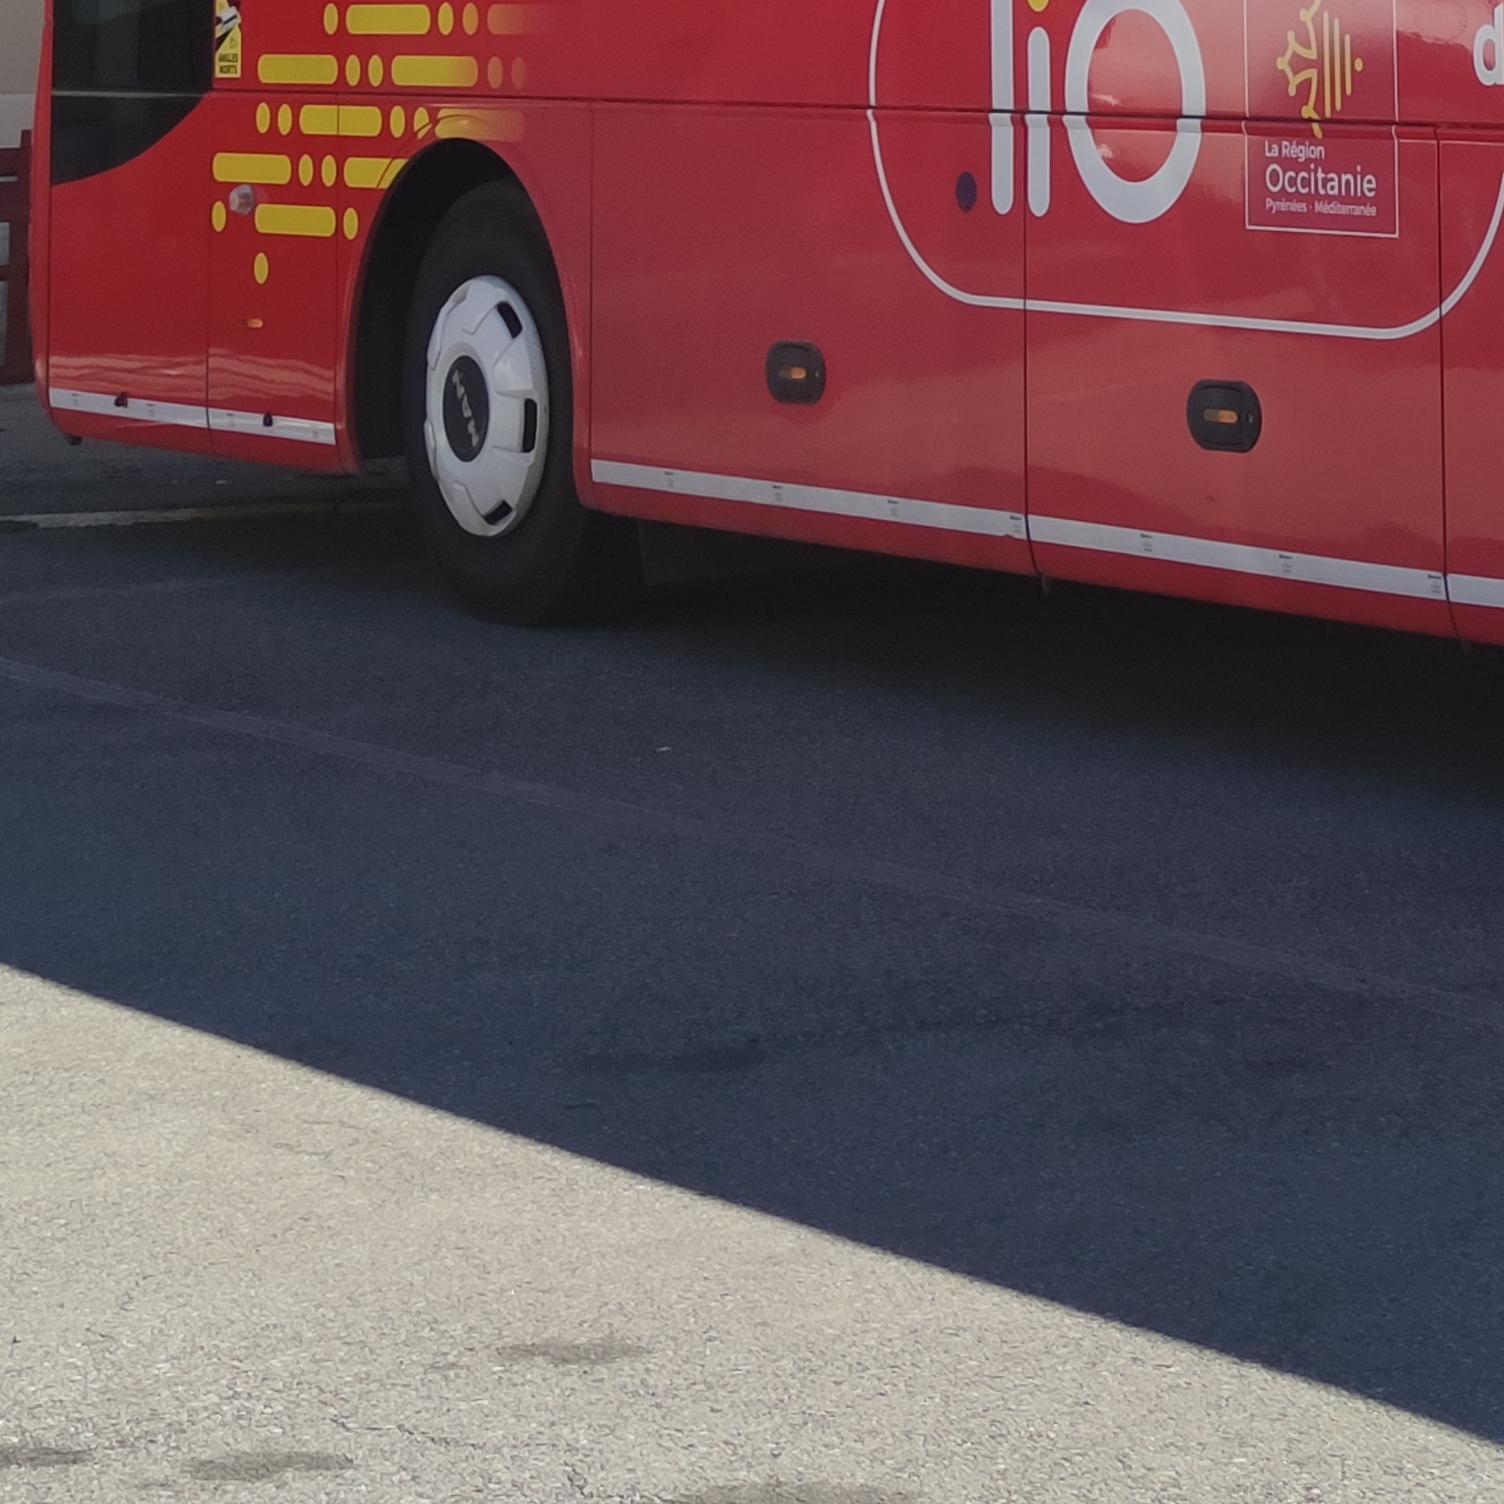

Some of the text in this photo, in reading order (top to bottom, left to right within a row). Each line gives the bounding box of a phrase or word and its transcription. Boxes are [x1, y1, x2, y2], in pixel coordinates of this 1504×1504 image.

[1264, 140, 1325, 162] La Région
[1265, 163, 1377, 198] Occitanie
[1265, 197, 1377, 217] Pyrénées Méditerranée
